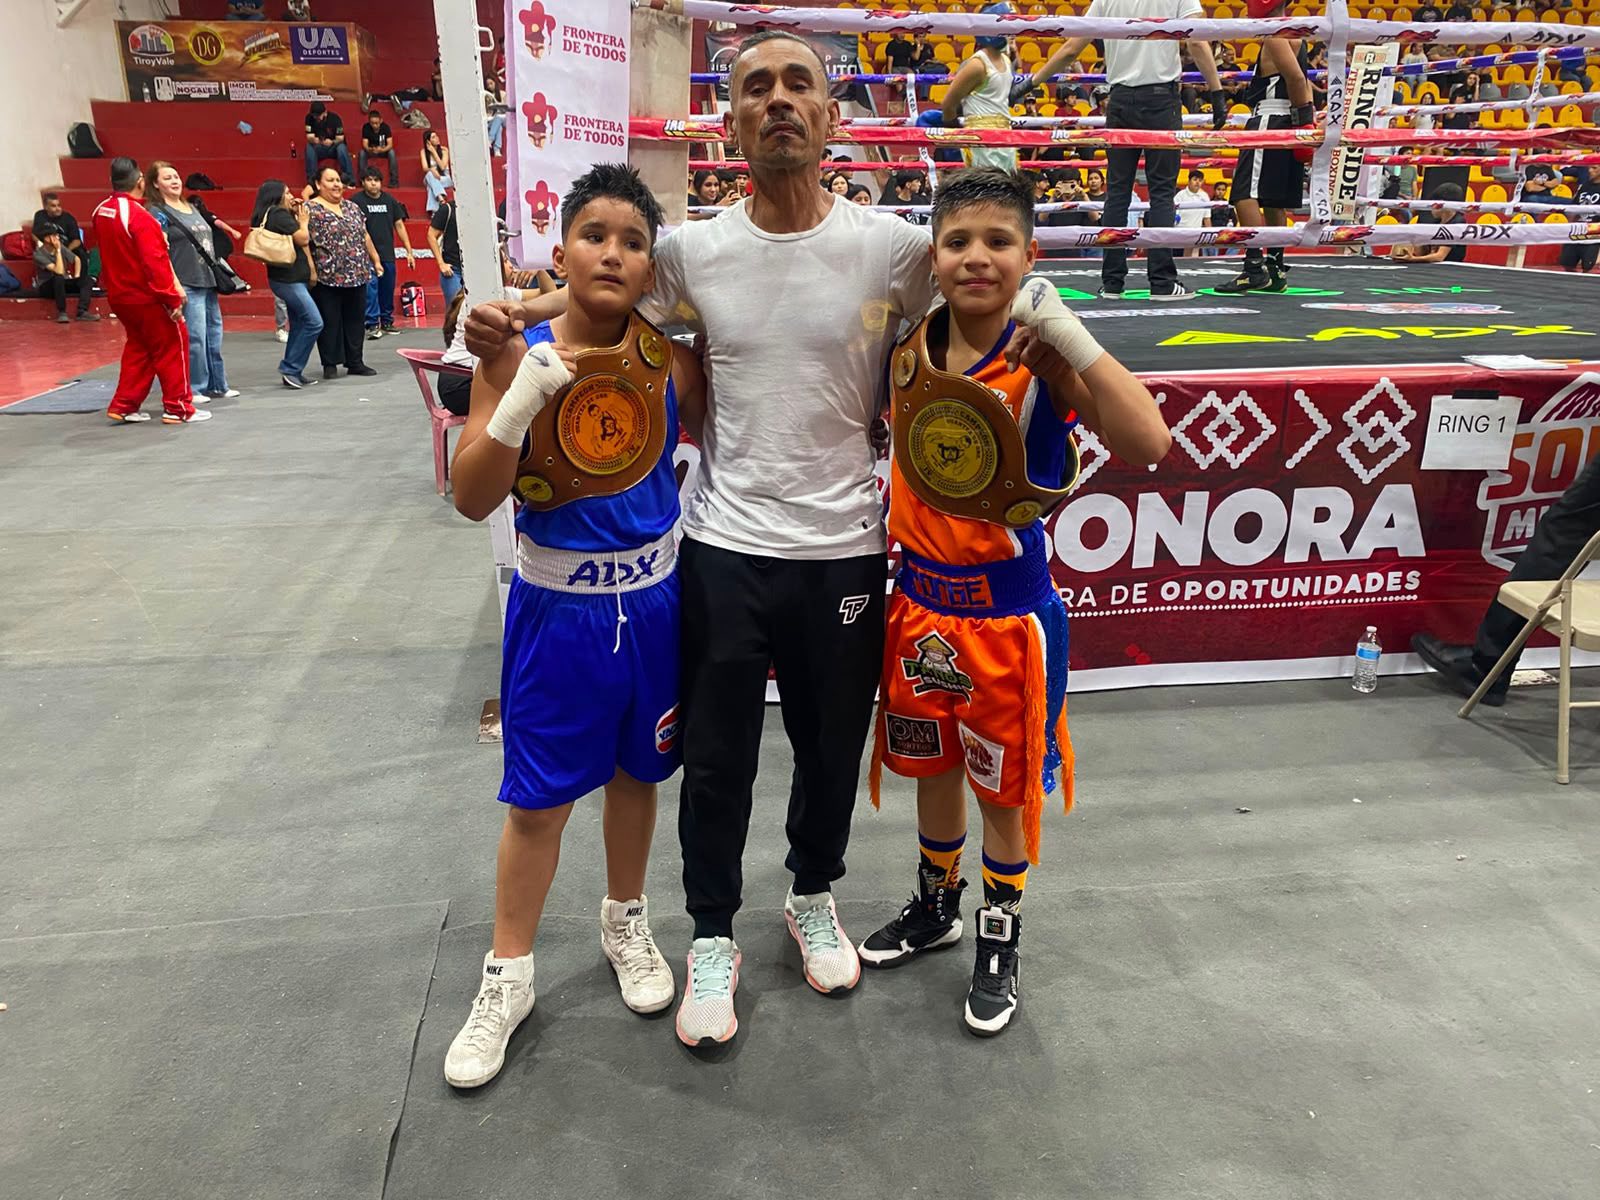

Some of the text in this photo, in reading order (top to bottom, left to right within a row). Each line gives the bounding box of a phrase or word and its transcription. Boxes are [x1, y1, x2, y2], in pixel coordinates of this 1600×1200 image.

[197, 36, 217, 57] DG
[298, 28, 341, 49] UA
[562, 25, 626, 49] FRONTERA
[562, 41, 627, 63] DE TODOS
[177, 86, 219, 94] NOGALES
[1327, 88, 1343, 126] ADX
[563, 114, 625, 133] FRONTERA
[563, 128, 625, 147] DE TODOS
[1460, 225, 1513, 241] ADX
[1306, 325, 1597, 342] ADX
[1438, 415, 1506, 433] RING 1
[1046, 484, 1427, 573] ONORA
[567, 549, 659, 588] ADX
[1110, 582, 1149, 605] DE
[1160, 570, 1422, 601] OPORTUNIDADES
[625, 906, 645, 918] NIKE
[485, 965, 504, 976] NIKE
